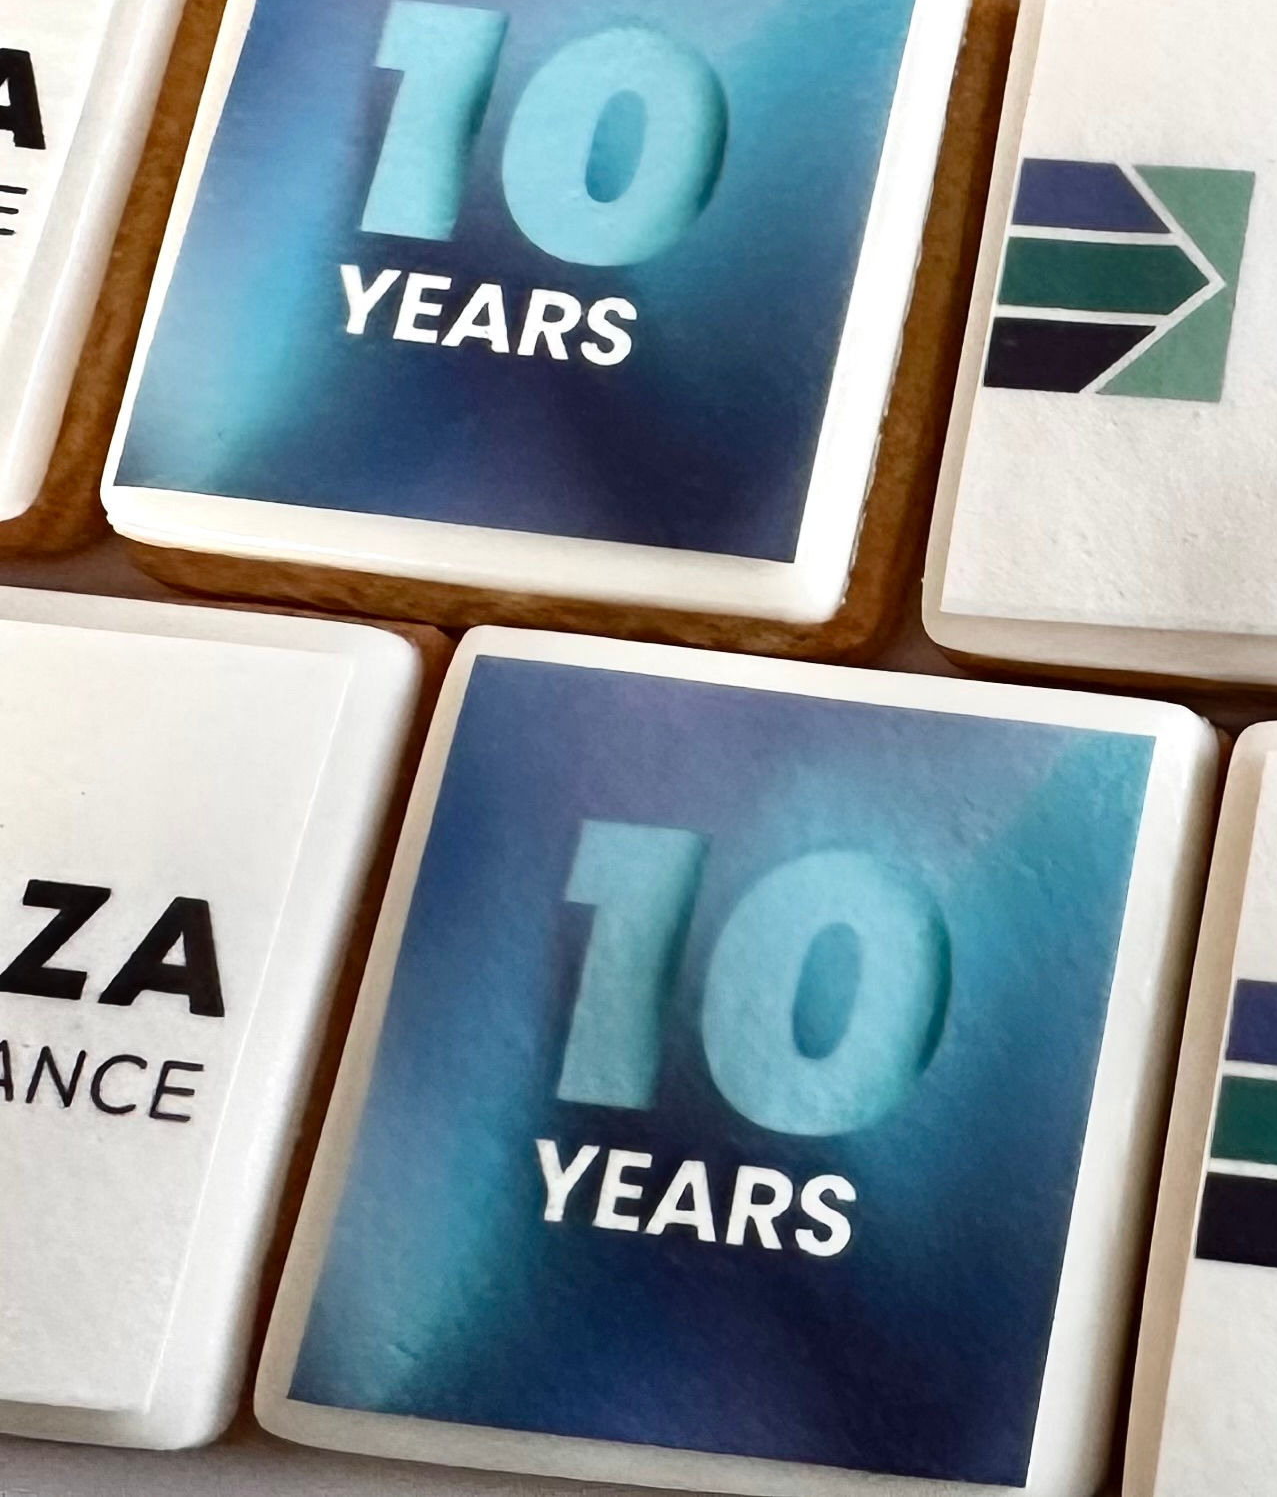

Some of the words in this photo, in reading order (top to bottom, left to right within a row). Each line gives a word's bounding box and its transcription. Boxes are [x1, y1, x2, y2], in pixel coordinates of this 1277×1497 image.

[340, 264, 637, 366] YEARS
[557, 818, 954, 1136] 10
[0, 1039, 204, 1124] NCE
[538, 1139, 856, 1257] YEARS
